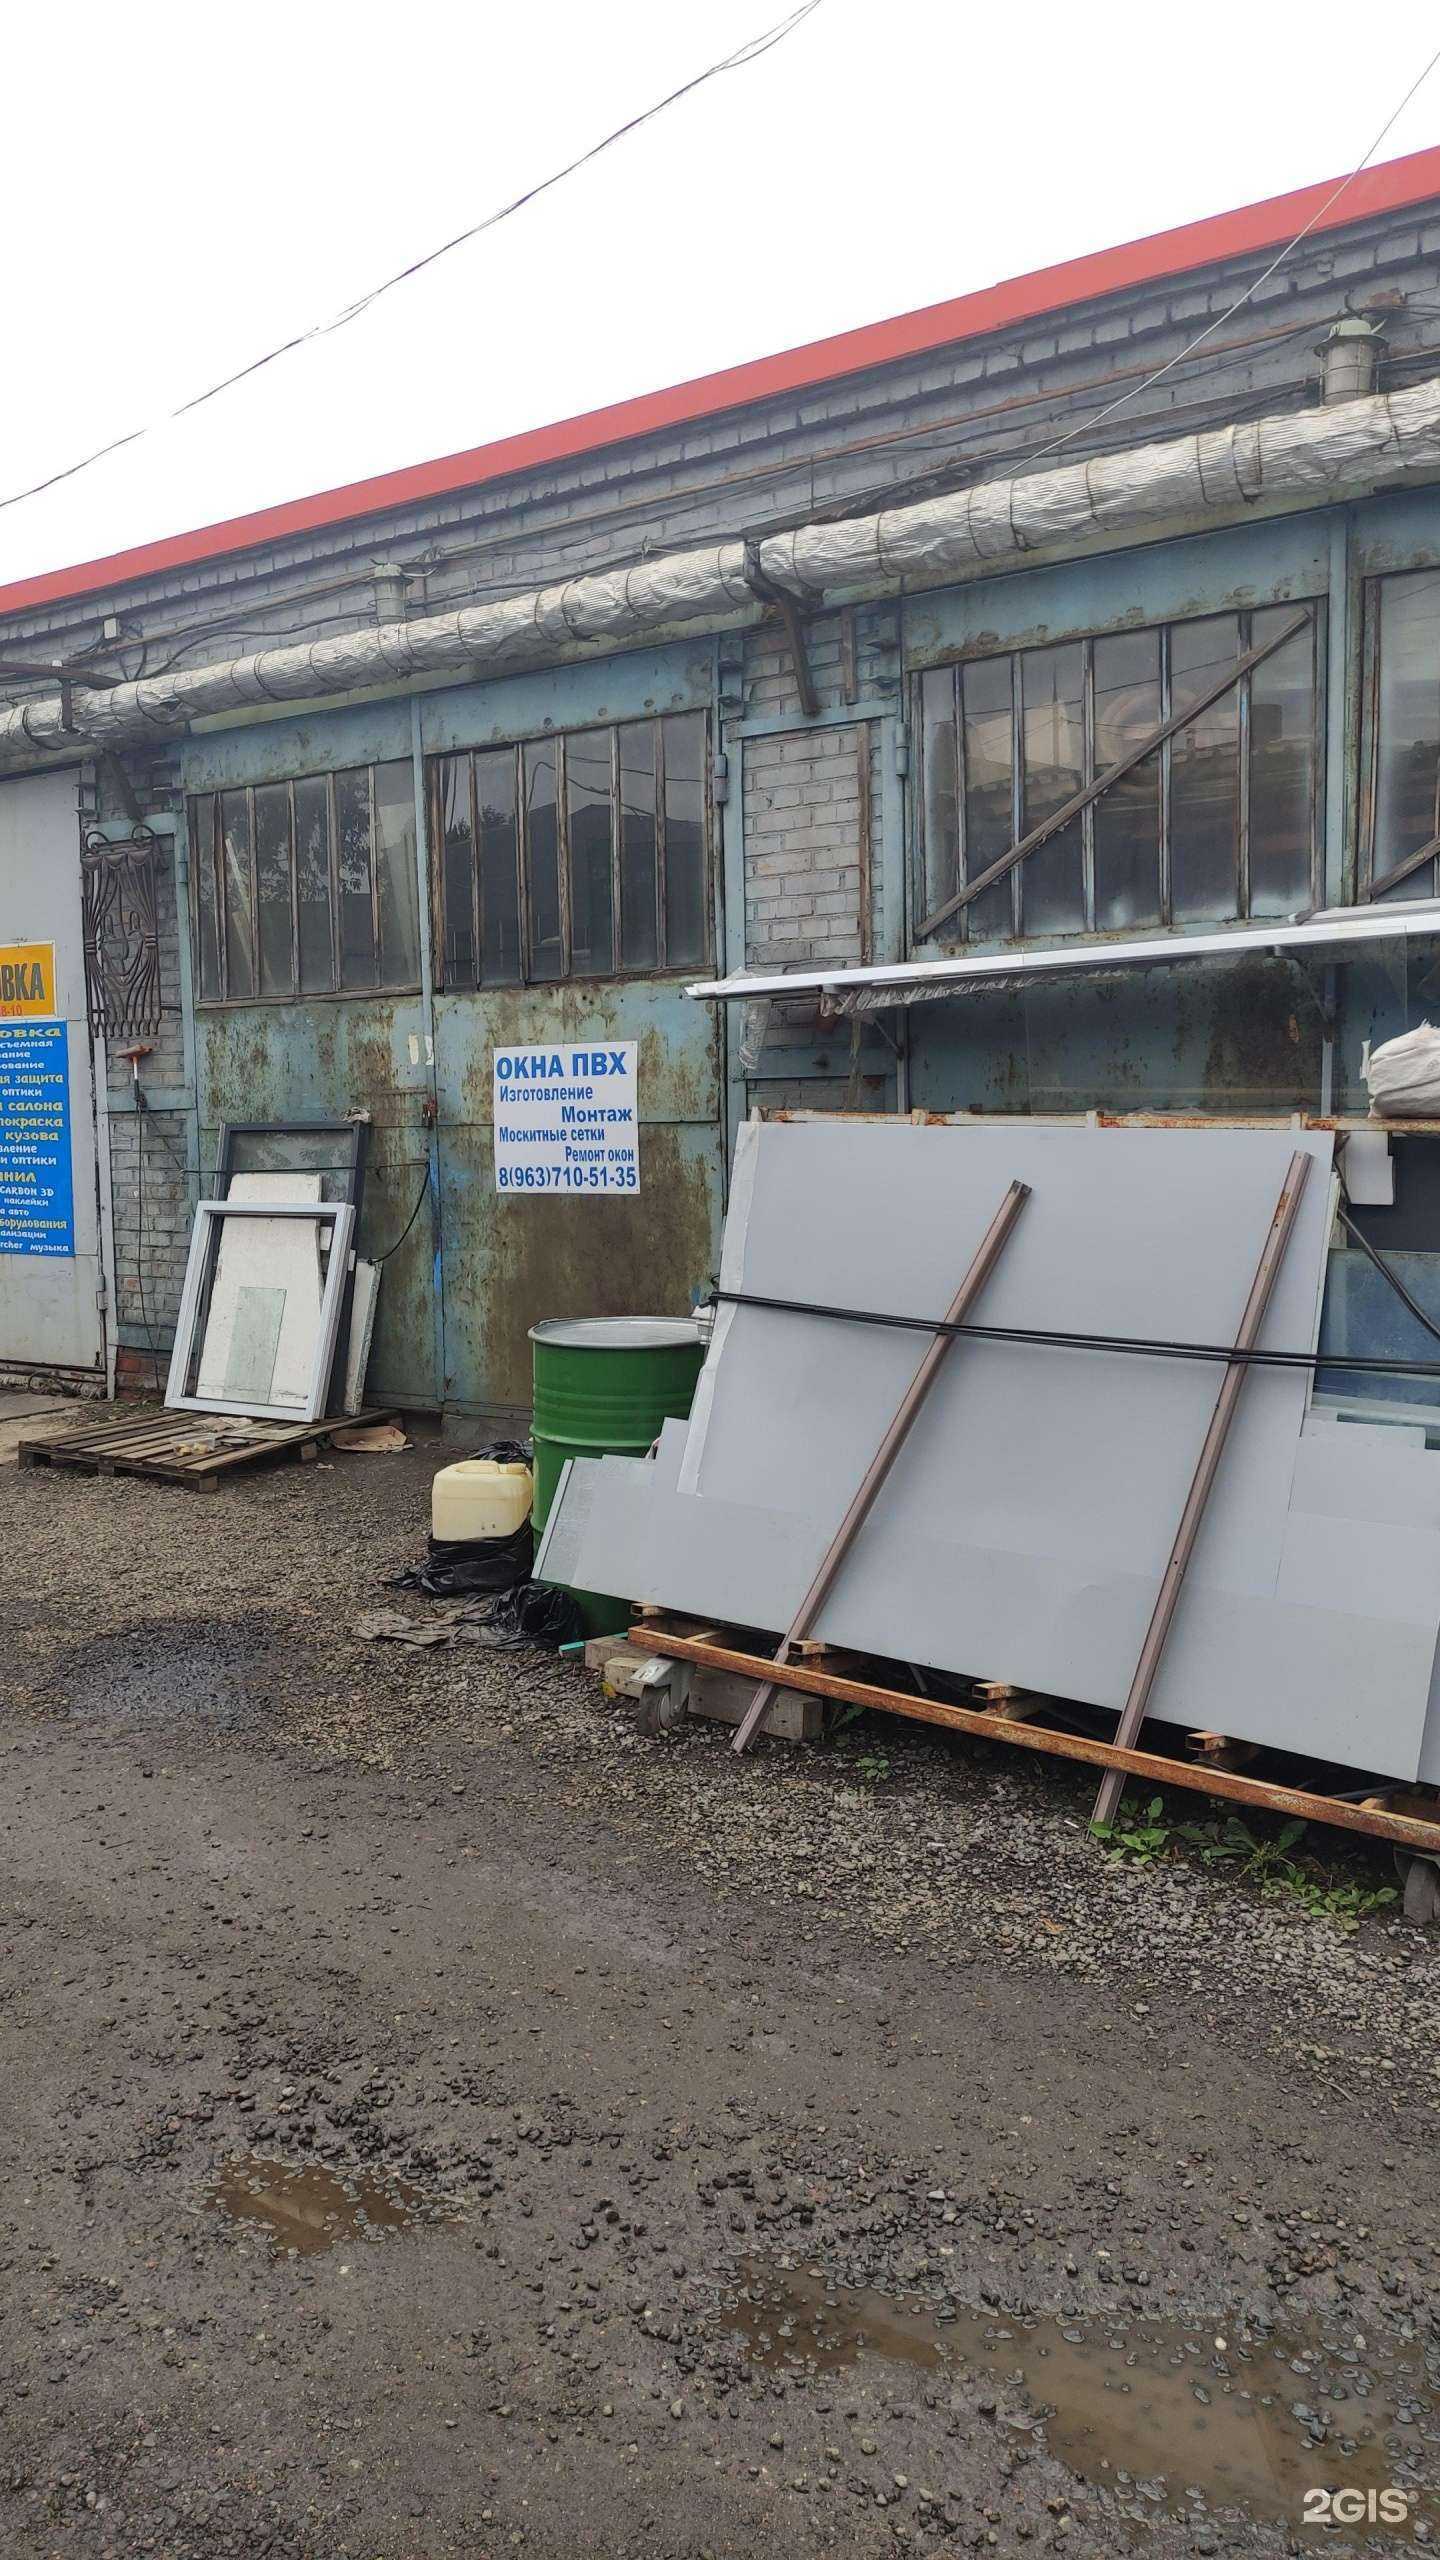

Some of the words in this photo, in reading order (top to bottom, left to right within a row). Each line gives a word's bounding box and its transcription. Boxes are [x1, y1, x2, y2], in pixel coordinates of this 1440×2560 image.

[0, 963, 45, 1001] ВКА
[0, 1051, 31, 1059] ание
[496, 1055, 564, 1079] ОКНА
[572, 1052, 627, 1077] ПВХ
[15, 1075, 63, 1085] защита
[2, 1088, 42, 1097] оптики
[500, 1086, 593, 1102] Изготовление
[8, 1102, 63, 1111] салона
[562, 1106, 632, 1123] Монтаж
[5, 1132, 59, 1143] кузова
[500, 1127, 567, 1142] Москитные
[571, 1127, 605, 1141] сетки
[565, 1146, 605, 1162] Ремонт
[608, 1149, 634, 1161] окон
[12, 1157, 57, 1165] оптики
[499, 1166, 636, 1187] 8(963)710-51-35
[30, 1244, 69, 1252] музыка
